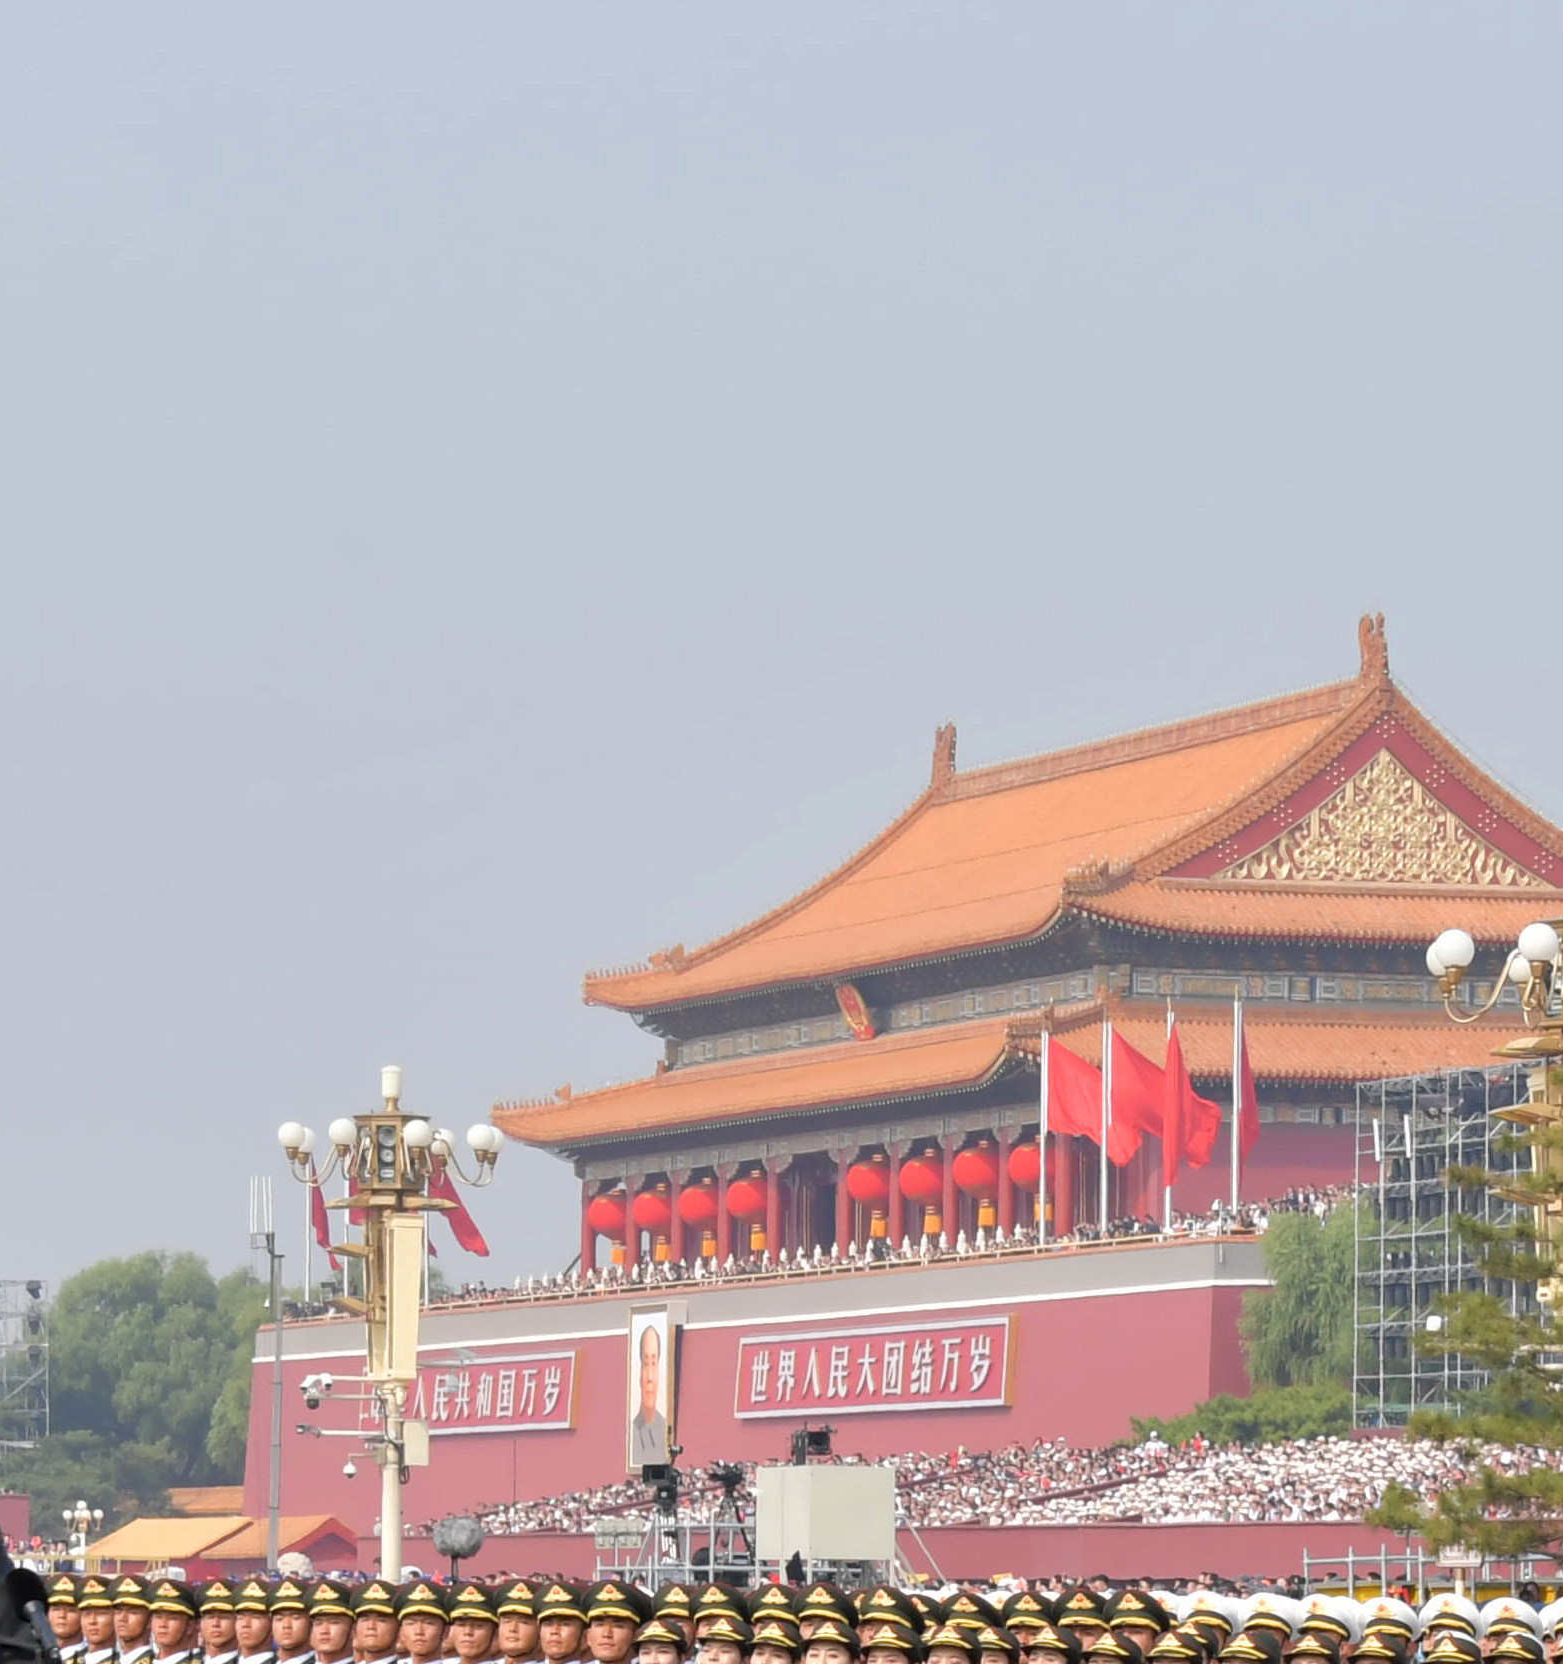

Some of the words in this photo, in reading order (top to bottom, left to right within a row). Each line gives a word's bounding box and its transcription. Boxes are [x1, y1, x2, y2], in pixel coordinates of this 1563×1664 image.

[370, 1366, 561, 1424] 人民共和国万岁
[751, 1334, 991, 1403] 世界人民大团结万岁
